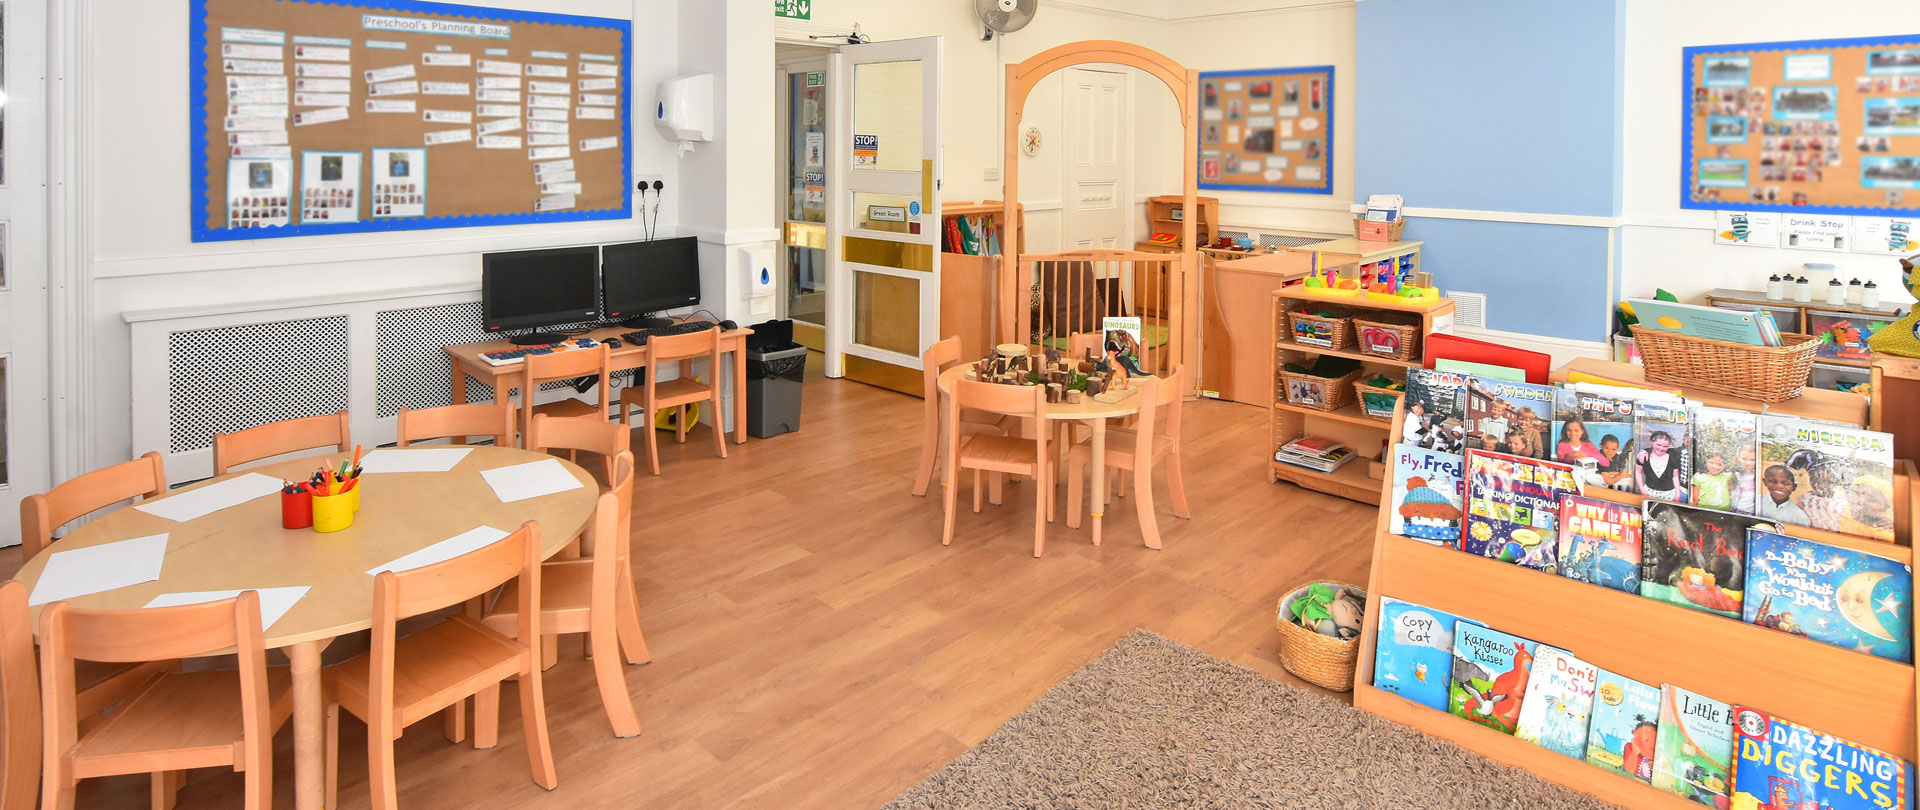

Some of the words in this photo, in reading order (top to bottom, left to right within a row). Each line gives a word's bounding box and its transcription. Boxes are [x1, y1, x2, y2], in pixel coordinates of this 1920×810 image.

[364, 16, 427, 30] Preschool's
[431, 22, 476, 34] Planning
[480, 26, 508, 36] Board
[855, 135, 878, 146] STOP!
[806, 173, 824, 182] STOP!
[873, 209, 887, 217] Green
[1790, 218, 1816, 226] Drink
[1820, 220, 1844, 229] Stop
[1104, 321, 1139, 330] DINOSAURS
[1582, 397, 1614, 413] THE
[1796, 428, 1885, 451] NIGERIA
[1401, 453, 1423, 471] Fly,
[1576, 503, 1607, 522] WHY
[1607, 507, 1619, 523] the
[1568, 515, 1622, 541] CAME
[1625, 524, 1634, 544] to
[1703, 522, 1722, 533] The
[1667, 528, 1705, 553] Red
[1781, 551, 1836, 576] Baby
[1784, 567, 1807, 579] Who
[1763, 567, 1834, 595] Wouldn't
[1758, 581, 1780, 596] Go
[1781, 587, 1794, 598] to
[1792, 589, 1833, 612] Bed
[1402, 615, 1433, 631] Copy
[1407, 630, 1431, 644] Cat
[1463, 631, 1515, 656] Kangaroo
[1474, 646, 1504, 666] Kisses
[1556, 657, 1595, 683] Don't
[1624, 680, 1654, 700] Lulu
[1683, 694, 1720, 723] Little
[1773, 725, 1893, 781] DAZZLING
[1742, 738, 1893, 808] DIGGERS
